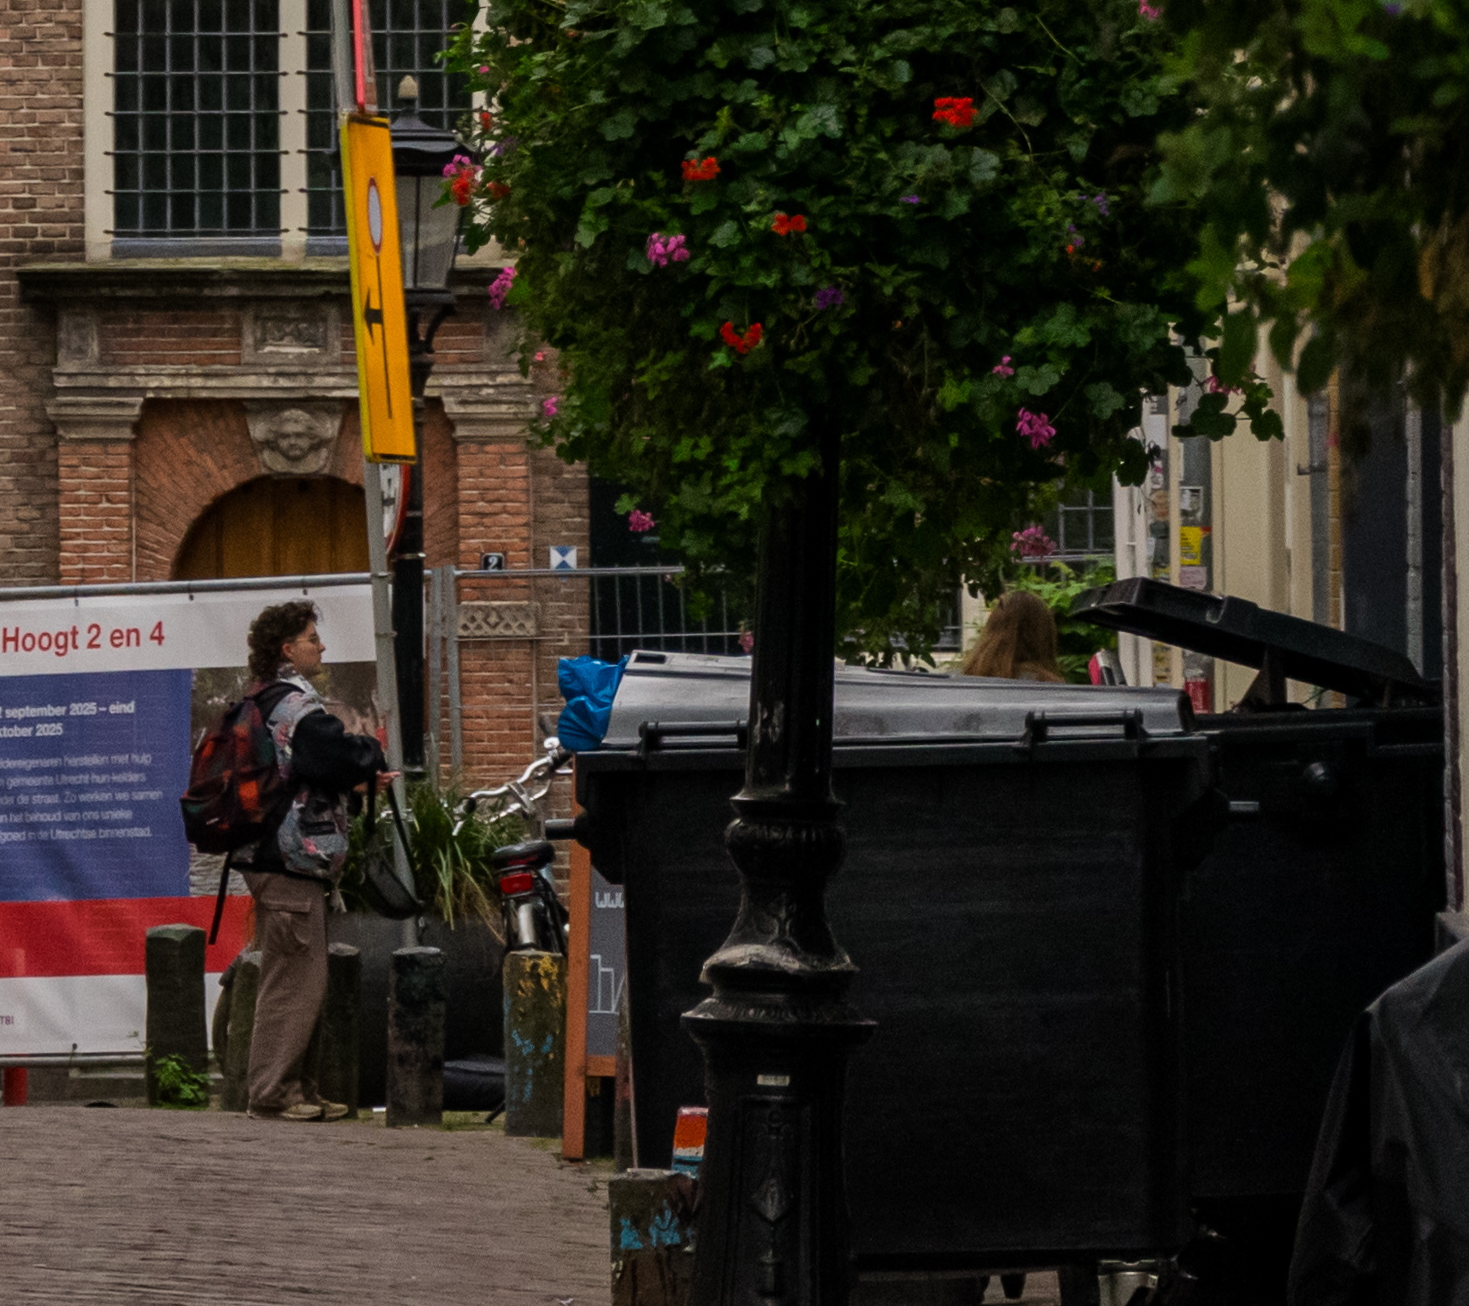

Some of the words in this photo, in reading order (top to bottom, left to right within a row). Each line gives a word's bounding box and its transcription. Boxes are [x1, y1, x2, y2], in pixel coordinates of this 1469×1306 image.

[488, 557, 498, 570] 2
[3, 625, 79, 657] Hoogt
[87, 623, 102, 650] 2
[110, 626, 141, 648] en
[149, 621, 165, 646] 4
[5, 703, 66, 720] september
[69, 702, 97, 716] 2025
[109, 700, 135, 714] eind
[35, 723, 63, 736] 2025
[63, 755, 108, 766] herstellen
[110, 754, 129, 765] met
[131, 753, 152, 765] hulp
[6, 776, 54, 789] gemeente
[56, 773, 89, 785] Utrecht
[91, 773, 110, 784] hun
[111, 771, 146, 783] kelders
[17, 794, 29, 804] de
[64, 792, 77, 803] Zo
[79, 791, 112, 803] werken
[114, 792, 129, 801] we
[132, 791, 162, 800] samen
[9, 812, 23, 823] het
[25, 811, 60, 822] behoud
[63, 812, 80, 822] van
[82, 811, 99, 821] ons
[101, 808, 133, 820] unieke
[50, 828, 97, 840] Utrechtse
[99, 826, 152, 839] binnenstad.
